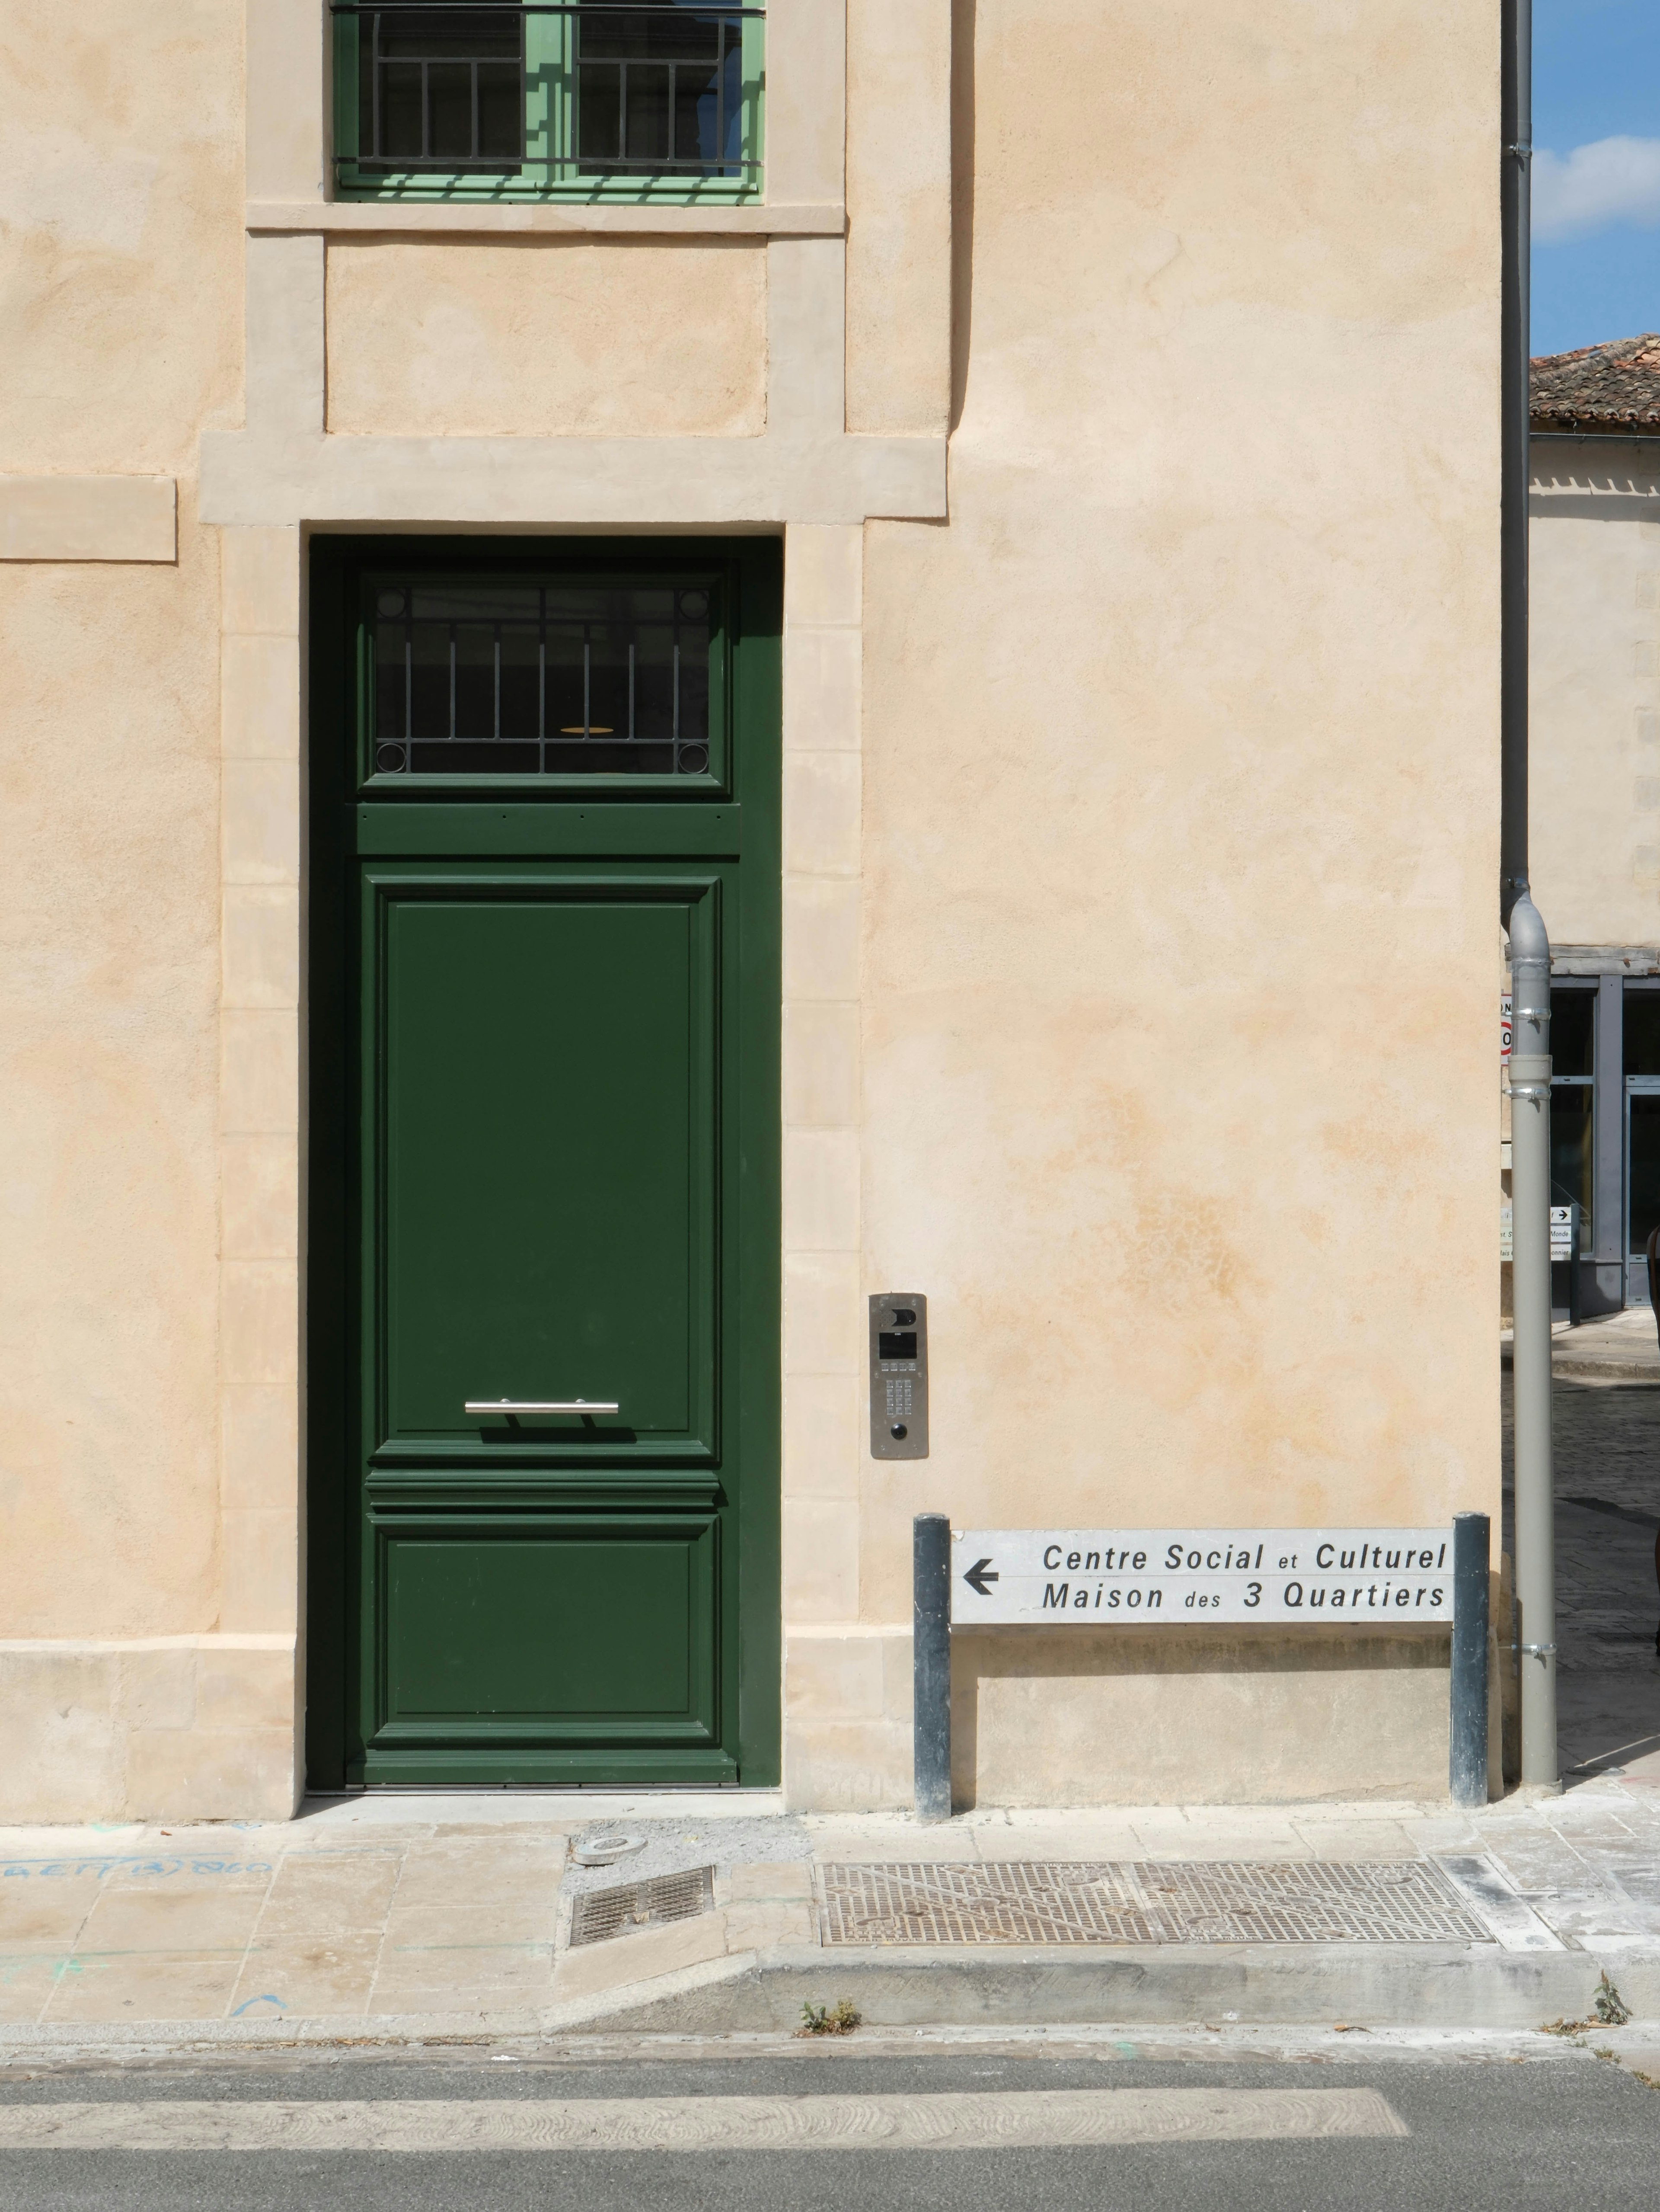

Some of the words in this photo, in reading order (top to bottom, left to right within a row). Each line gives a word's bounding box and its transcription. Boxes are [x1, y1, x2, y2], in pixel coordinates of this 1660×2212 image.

[1044, 1544, 1148, 1570] Centre
[1165, 1544, 1264, 1569] Social
[1279, 1554, 1298, 1569] et
[1316, 1543, 1446, 1569] Culturel
[1043, 1583, 1162, 1608] Maison
[1185, 1591, 1221, 1608] des
[1243, 1582, 1262, 1608] 3
[1283, 1582, 1444, 1608] Quartiers
